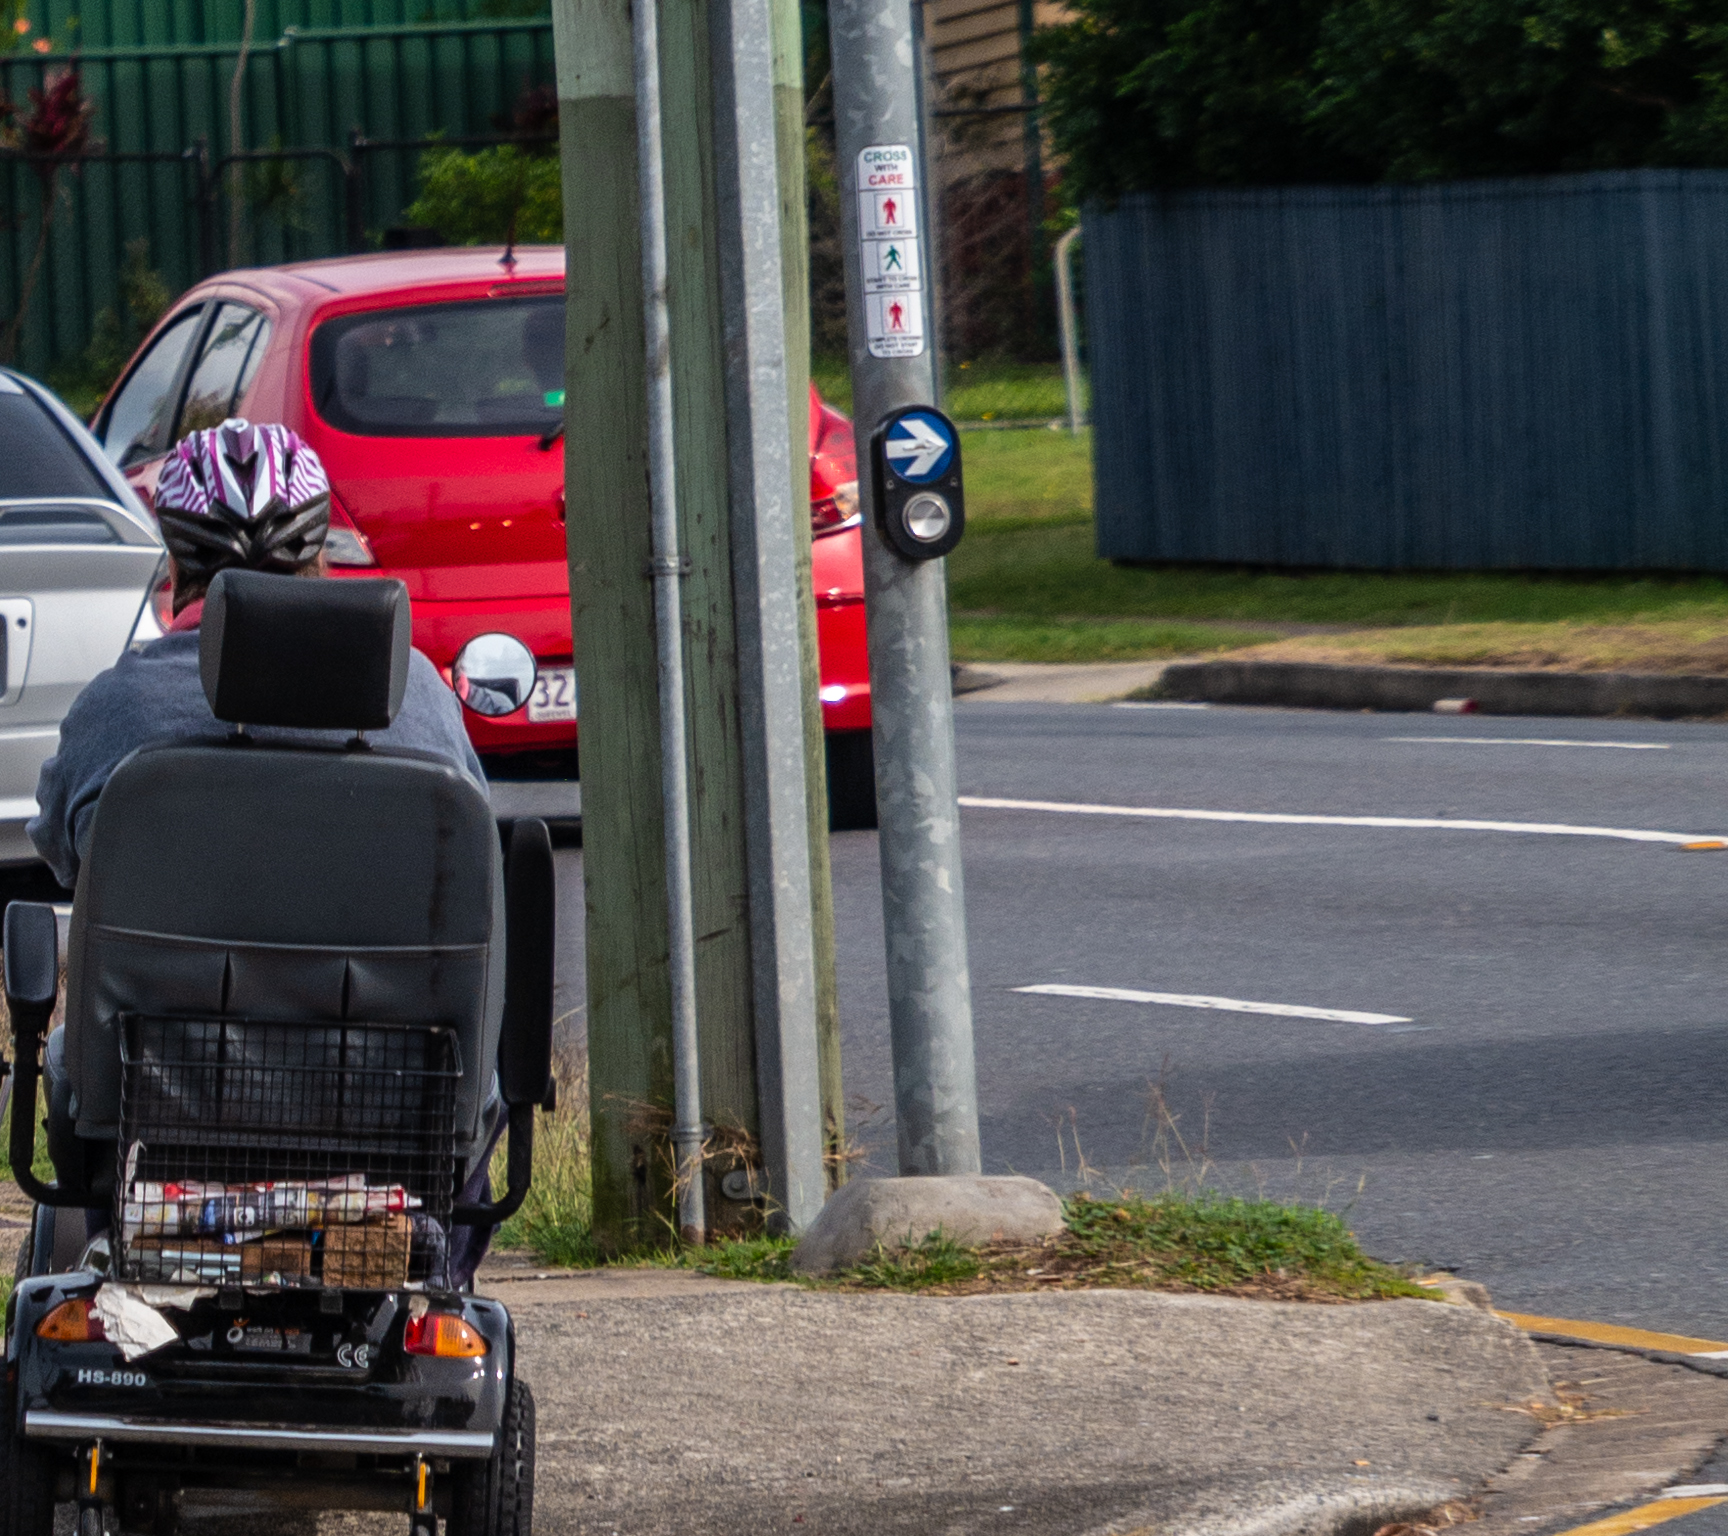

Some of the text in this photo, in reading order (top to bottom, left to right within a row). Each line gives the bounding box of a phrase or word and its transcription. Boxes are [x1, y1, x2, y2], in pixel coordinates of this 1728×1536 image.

[864, 150, 907, 163] CROSS
[874, 164, 898, 172] WITH
[868, 173, 904, 185] CARE
[77, 1368, 147, 1387] HS-890
